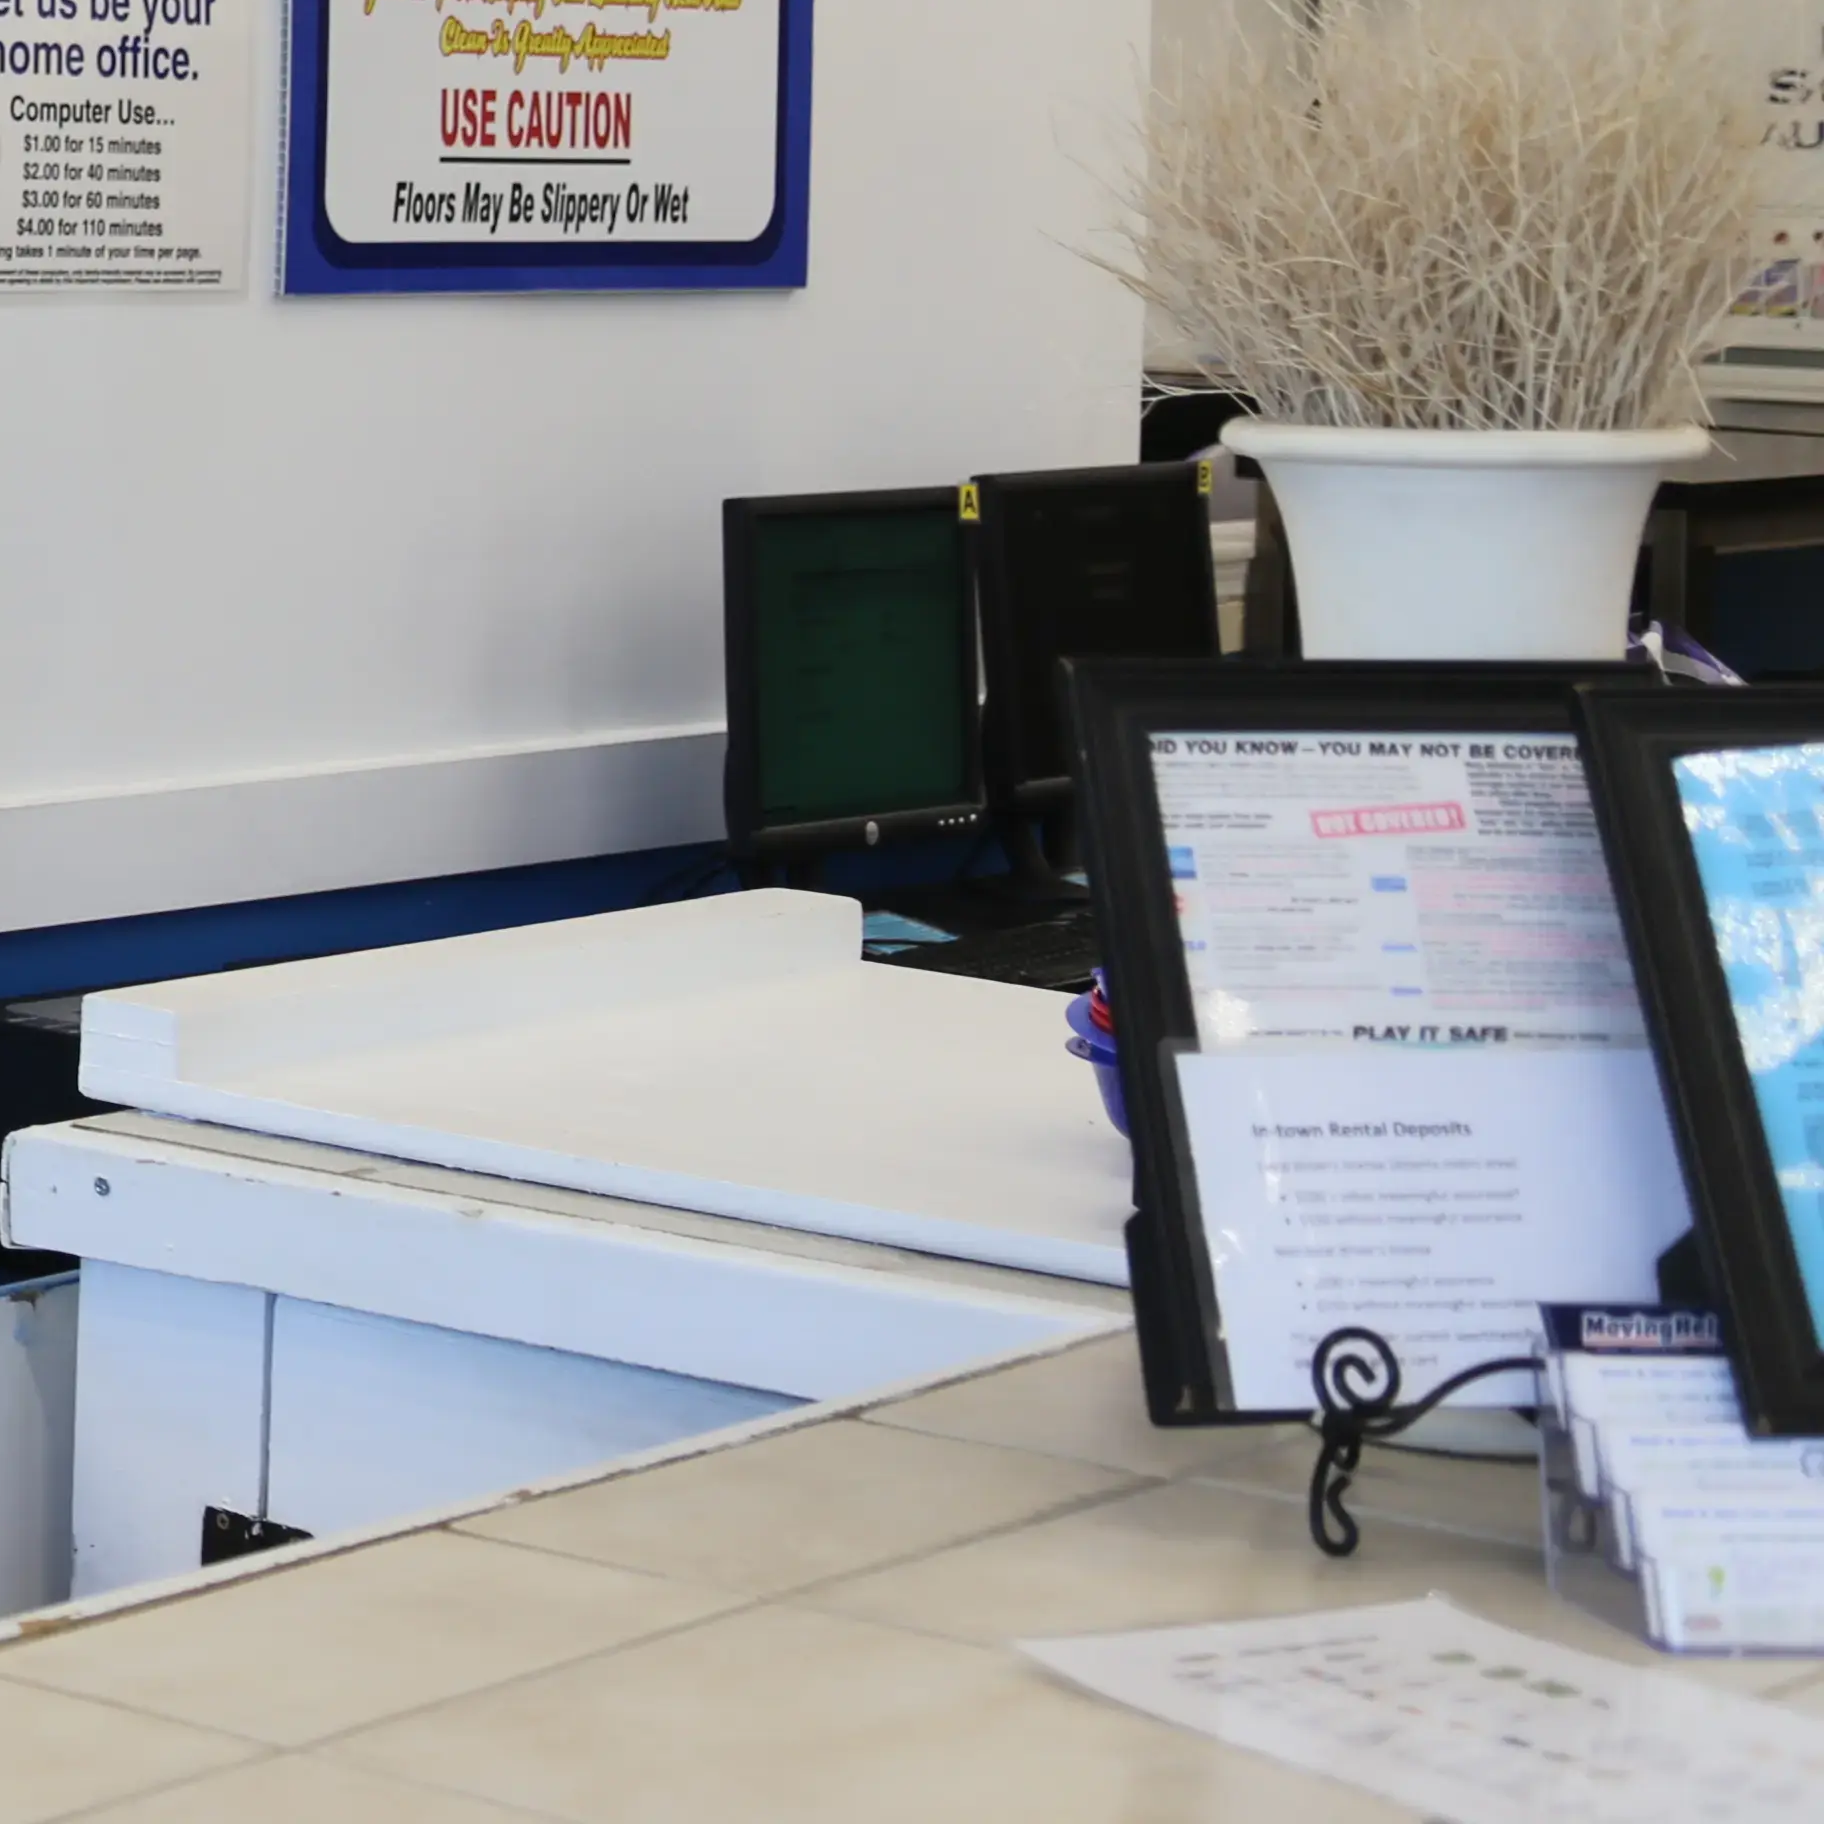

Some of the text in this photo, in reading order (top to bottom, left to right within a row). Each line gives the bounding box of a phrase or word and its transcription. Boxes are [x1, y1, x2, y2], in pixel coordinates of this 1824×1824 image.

[97, 35, 198, 81] office.
[10, 95, 112, 127] Computer
[440, 89, 631, 149] USE CAUTION
[393, 182, 689, 234] Floors May Be Slippery Or Wet
[963, 492, 976, 513] A
[1186, 740, 1227, 755] YOU
[1369, 742, 1411, 758] MAY
[1421, 743, 1461, 759] NOT
[1469, 744, 1495, 760] BE
[1352, 1025, 1507, 1042] PLAY IT SAFE
[1253, 1120, 1471, 1140] In-town Rental Deposits
[1582, 1313, 1717, 1346] MovingHel
